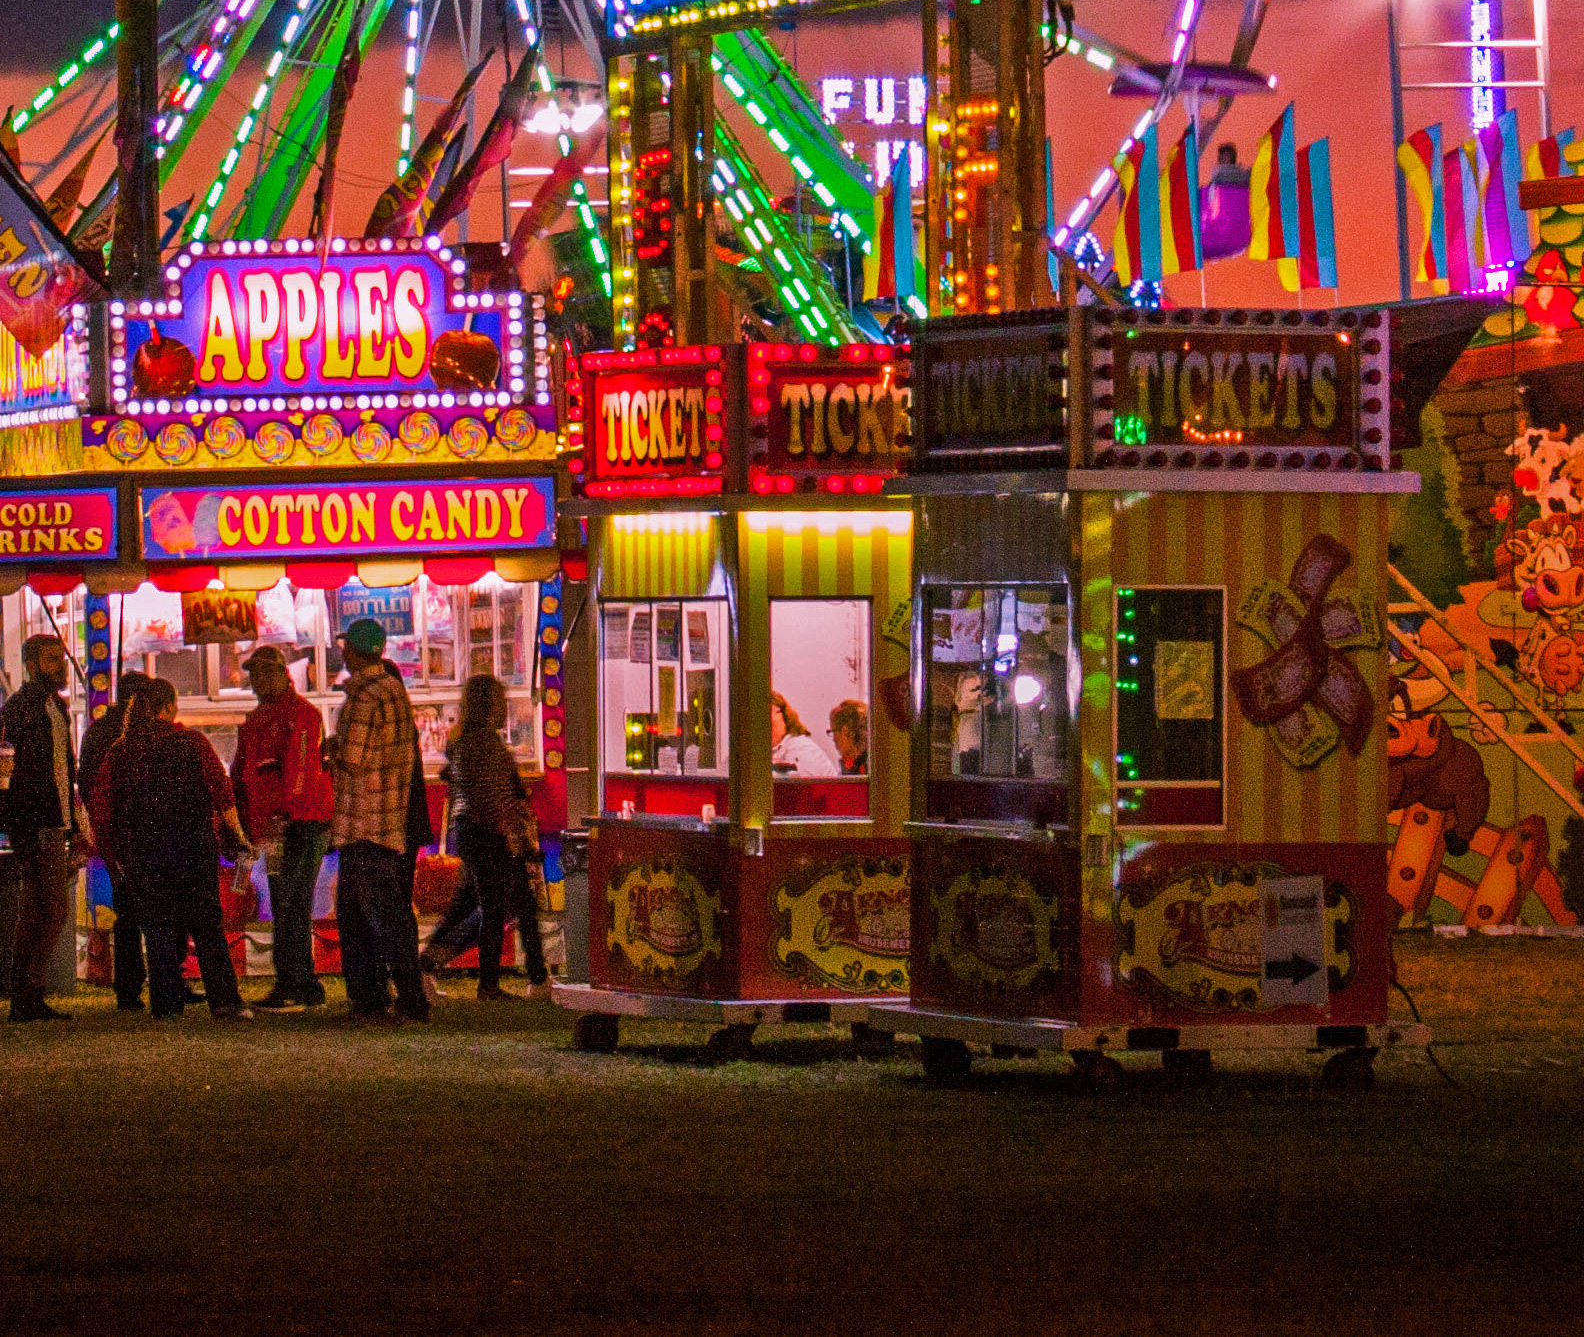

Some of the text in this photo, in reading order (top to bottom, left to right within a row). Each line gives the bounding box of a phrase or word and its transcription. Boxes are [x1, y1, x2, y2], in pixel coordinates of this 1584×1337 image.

[198, 267, 430, 387] APPLES
[781, 383, 910, 454] TICKE
[1128, 351, 1338, 430] TICKETS
[218, 486, 528, 548] COTTON CANDY
